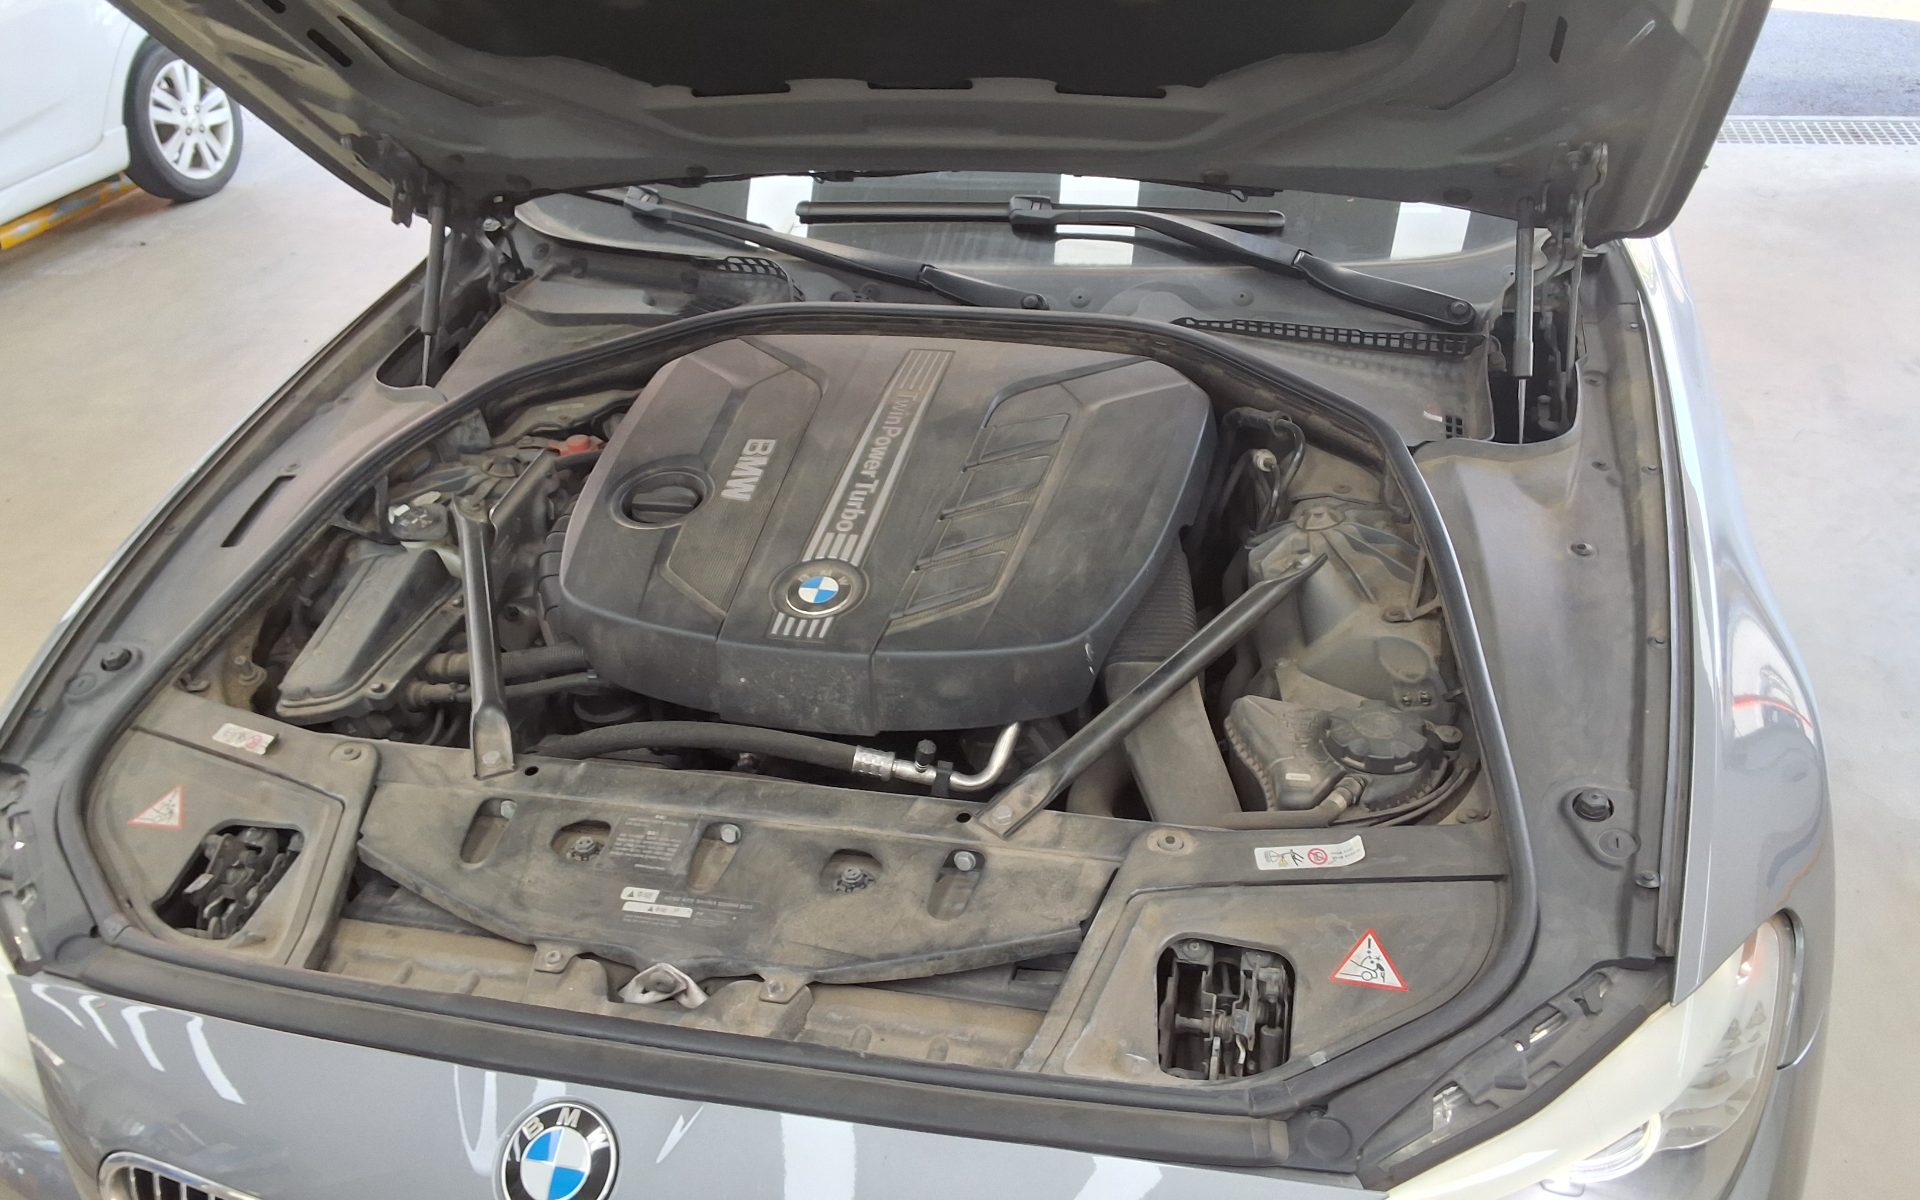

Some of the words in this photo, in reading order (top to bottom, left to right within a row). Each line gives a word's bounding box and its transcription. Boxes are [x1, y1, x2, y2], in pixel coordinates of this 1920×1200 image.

[860, 391, 918, 478] TwinPower
[720, 438, 777, 502] BMW
[836, 479, 879, 533] Turbo
[521, 1106, 610, 1151] BMW
